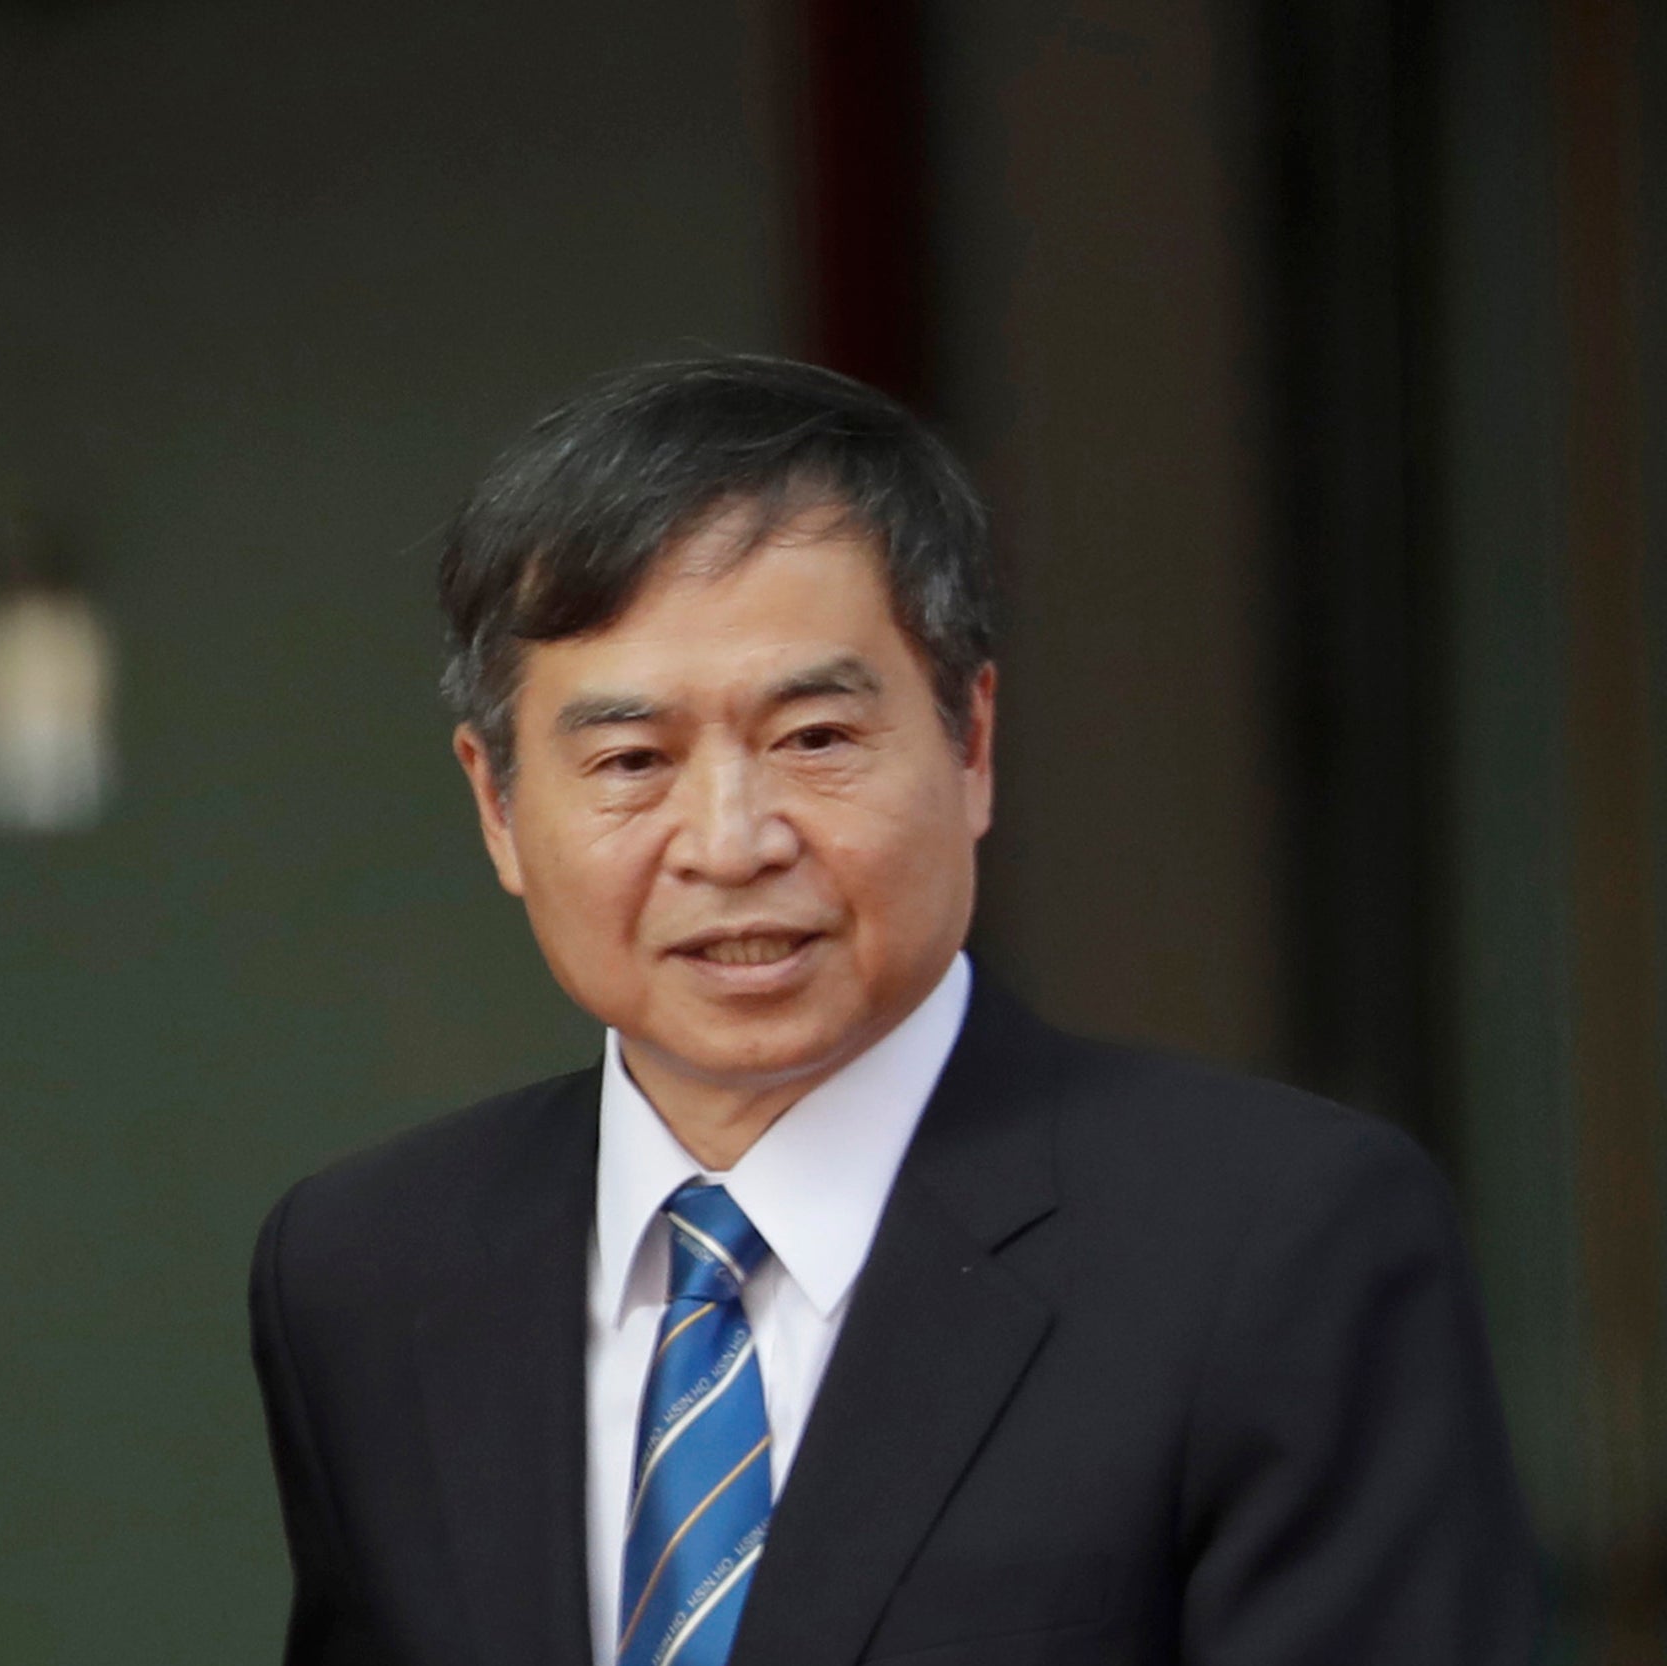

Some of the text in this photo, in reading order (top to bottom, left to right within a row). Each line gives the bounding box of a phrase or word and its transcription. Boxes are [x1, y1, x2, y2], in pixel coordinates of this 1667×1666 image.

[690, 1376, 710, 1400] HO
[686, 1575, 717, 1609] HSIN
[712, 1557, 734, 1581] HO
